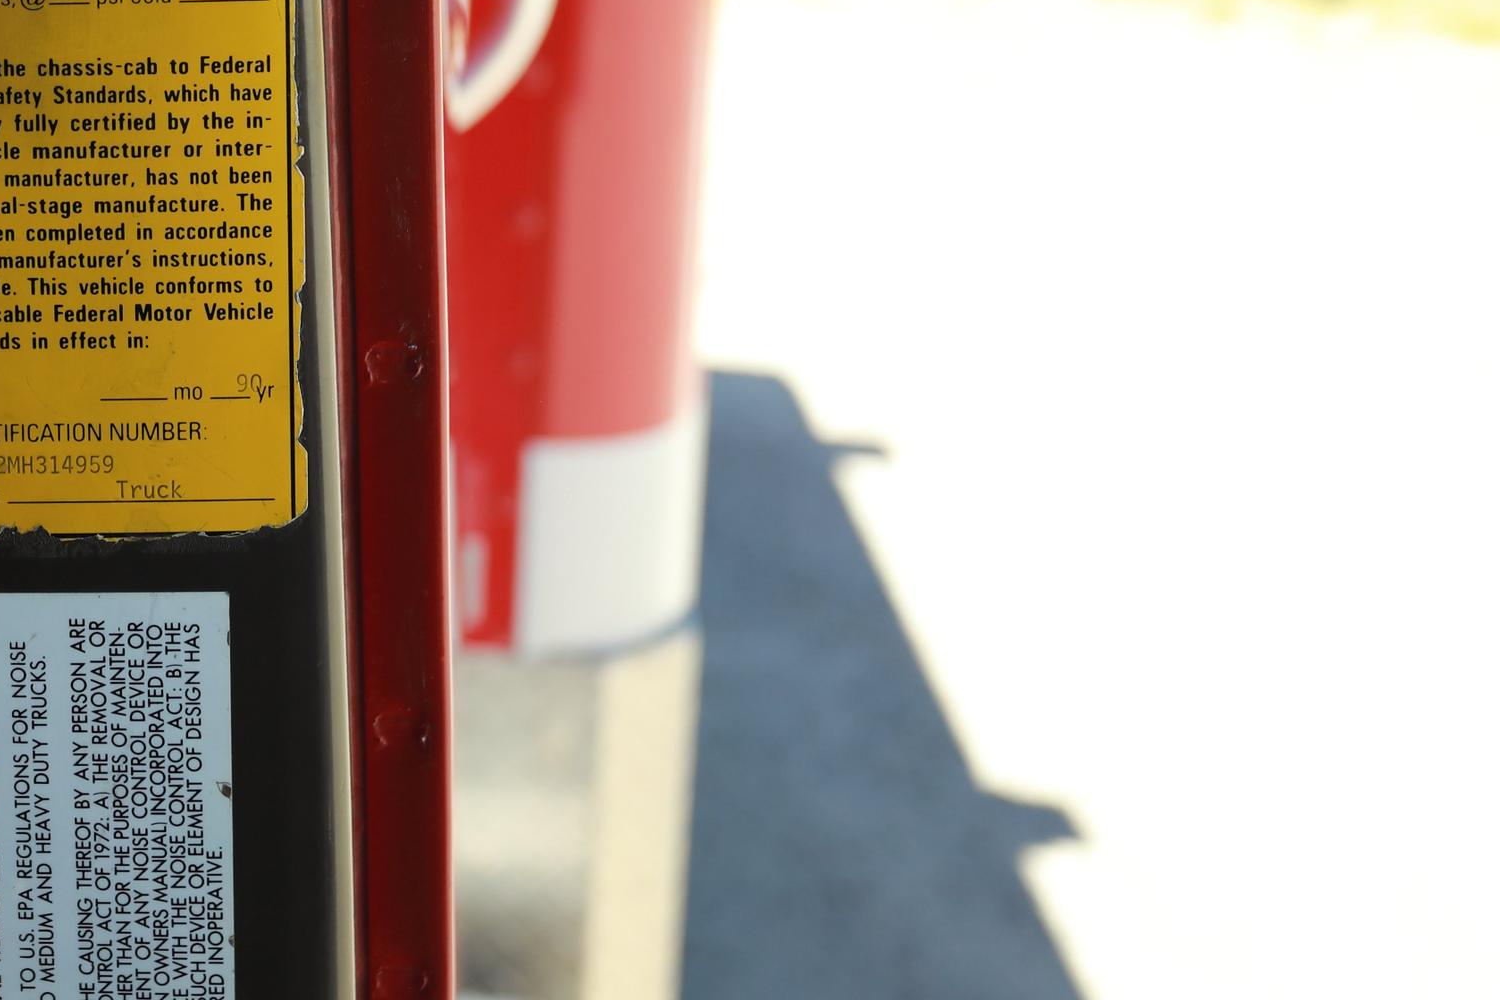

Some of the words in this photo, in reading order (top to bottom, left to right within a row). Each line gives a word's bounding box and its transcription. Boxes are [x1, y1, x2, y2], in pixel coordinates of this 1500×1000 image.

[37, 56, 158, 77] chassis-cab
[169, 59, 189, 75] to
[200, 55, 271, 74] Federal
[53, 85, 152, 105] Standards,
[164, 84, 219, 102] which
[230, 84, 272, 101] have
[32, 141, 171, 159] manufacturer
[183, 142, 203, 158] or
[215, 140, 272, 157] inter-
[94, 195, 225, 214] manufacture.
[236, 193, 272, 211] The
[152, 248, 274, 268] instructions,
[53, 304, 124, 322] Federal
[135, 303, 192, 322] Motor
[204, 301, 274, 321] Vehicle
[32, 331, 48, 349] in
[59, 330, 116, 349] effect
[127, 330, 150, 349] in:
[174, 383, 203, 401] mo
[236, 373, 262, 393] 90
[257, 380, 275, 403] yr
[109, 420, 208, 442] NUMBER:
[116, 480, 183, 500] Truck
[69, 618, 85, 652] ARE
[145, 625, 163, 668] INTO
[183, 623, 200, 662] HAS
[10, 641, 27, 698] NOISE
[31, 655, 48, 729] TRUCKS.
[70, 663, 88, 734] PERSON
[184, 671, 202, 740] DESIGN
[11, 709, 29, 744] FOR
[33, 739, 50, 784] DUTY
[73, 743, 89, 781] ANY
[146, 679, 167, 815] INCORPORATED
[185, 747, 202, 772] OF
[13, 754, 33, 880] REGULATIONS
[74, 789, 90, 809] BY
[34, 800, 52, 855] HEAVY
[186, 782, 204, 859] ELEMENT
[74, 817, 92, 889] THEREOF
[149, 823, 170, 893] MANUAL)
[37, 868, 53, 904] AND
[186, 864, 204, 889] OR
[16, 894, 34, 921] EPA
[205, 846, 225, 964] INOPERATIVE.
[76, 897, 94, 975] CAUSING
[187, 896, 205, 954] DEVICE
[19, 928, 35, 960] U.S.
[37, 912, 55, 982] MEDIUM
[153, 908, 170, 987] OWNERS
[20, 964, 36, 992] TO
